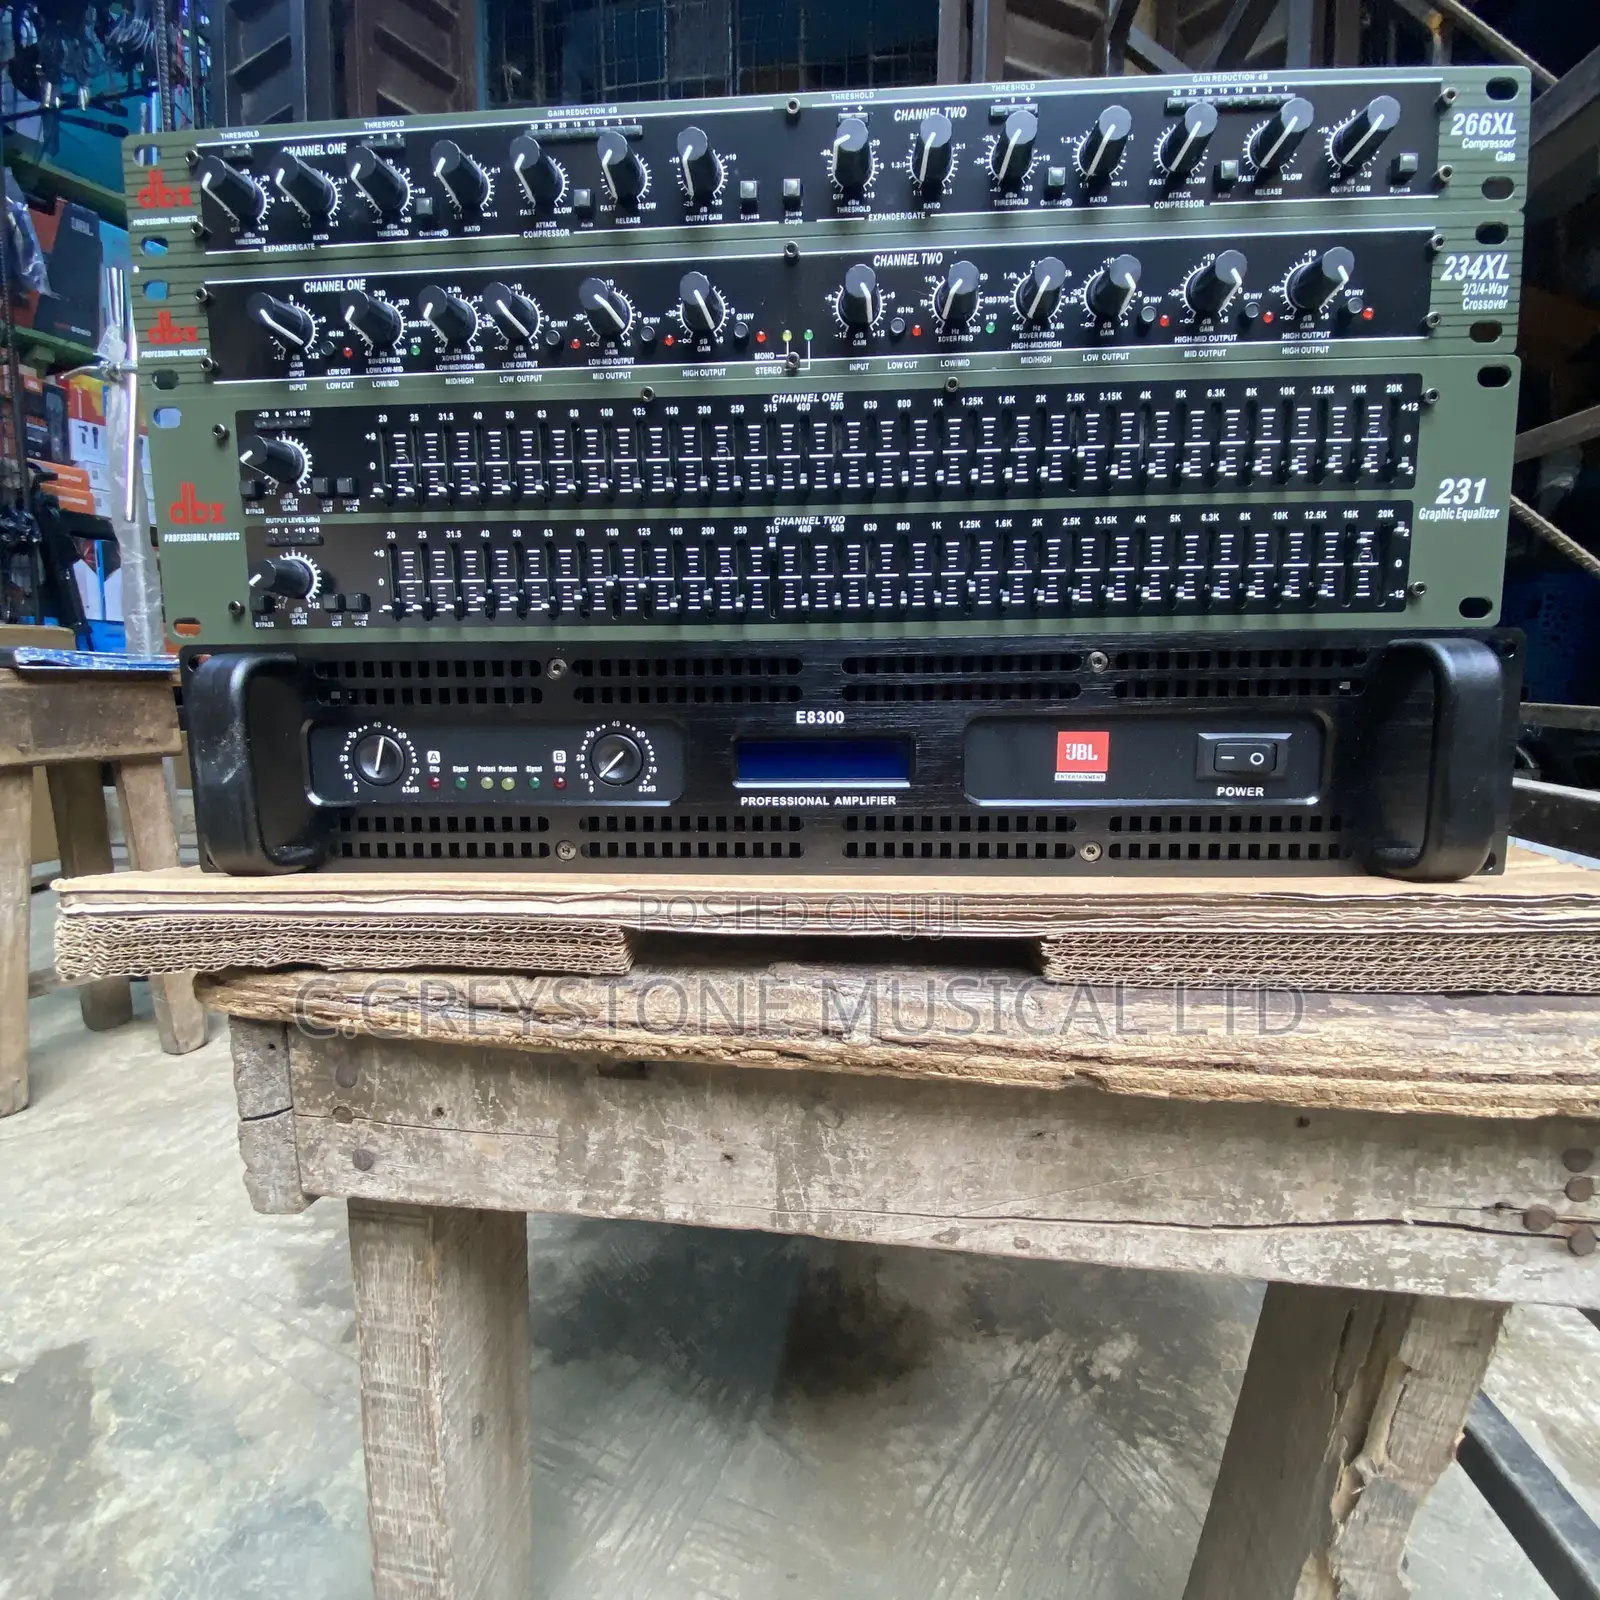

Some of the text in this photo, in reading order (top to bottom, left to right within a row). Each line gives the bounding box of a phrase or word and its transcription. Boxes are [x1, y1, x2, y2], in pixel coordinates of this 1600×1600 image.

[1193, 75, 1210, 83] GAIN
[832, 92, 874, 100] THRESHOLD
[566, 108, 605, 116] REDUCTION
[945, 106, 967, 118] TWO
[364, 120, 404, 129] THRESHOLD
[1451, 113, 1516, 135] 266XL
[220, 131, 259, 139] THRESHOLD
[327, 142, 347, 155] ONE
[1496, 151, 1516, 162] Gate
[138, 169, 192, 208] dbx
[1154, 200, 1204, 209] COMPRESSOR
[133, 218, 169, 226] PROFESSIONAL
[869, 212, 925, 221] EXPANDER/GATE
[524, 229, 569, 238] COMPRESSOR
[264, 243, 315, 252] EXPANDER/GATE
[874, 252, 943, 266] CHANNEL TWO
[1441, 254, 1510, 281] 234XL
[304, 279, 366, 292] CHANNEL ONE
[1462, 283, 1509, 297] 2/3/4-Way
[1463, 297, 1508, 310] Crossover
[148, 311, 200, 344] dbx
[141, 350, 178, 358] PROFESSIONAL
[755, 352, 774, 360] MONO
[850, 363, 869, 371] INPUT
[888, 362, 903, 370] LOW
[941, 359, 970, 367] LOW/MID
[1021, 356, 1052, 364] MID/HIGH
[1102, 352, 1130, 360] OUTPUT
[1184, 350, 1197, 358] MID
[1199, 349, 1226, 357] OUTPUT
[1301, 346, 1329, 354] OUTPUT
[327, 382, 340, 390] LOW
[341, 381, 354, 389] CUT
[372, 380, 399, 388] LOW/MID
[517, 375, 542, 383] OUTPUT
[606, 371, 631, 380] OUTPUT
[438, 413, 454, 421] 31.5
[473, 412, 482, 420] 40
[506, 411, 514, 419] 50
[537, 410, 547, 418] 63
[600, 409, 613, 417] 100
[633, 408, 646, 416] 125
[666, 407, 678, 415] 160
[698, 406, 711, 414] 200
[731, 405, 744, 413] 250
[764, 404, 777, 412] 315
[797, 403, 810, 412] 400
[831, 402, 844, 410] 500
[864, 401, 877, 409] 630
[898, 400, 911, 408] 800
[933, 399, 943, 407] 1K
[961, 397, 984, 406] 1.25K
[998, 396, 1015, 404] 1.6K
[1036, 395, 1047, 403] 2K
[1067, 393, 1085, 402] 2.5K
[1100, 392, 1122, 400] 3.15K
[1140, 391, 1151, 399] 4K
[1176, 390, 1186, 398] 5K
[1207, 389, 1225, 397] 6.3K
[1246, 388, 1257, 396] 8K
[1279, 387, 1295, 395] 10K
[1312, 386, 1334, 394] 12.5K
[1351, 385, 1367, 393] 16K
[1387, 384, 1402, 392] 20K
[772, 393, 844, 403] CHANNEL ONE
[1436, 478, 1486, 504] 231
[170, 482, 226, 525] dbx
[1419, 507, 1499, 522] Graphic Equalizer
[606, 528, 619, 536] 100
[702, 527, 715, 535] 200
[864, 523, 877, 531] 630
[932, 521, 942, 529] 1K
[1032, 518, 1043, 526] 2K
[1135, 515, 1146, 523] 4K
[1273, 512, 1288, 520] 10K
[1378, 509, 1394, 518] 20K
[774, 516, 845, 525] CHANNEL TWO
[164, 532, 240, 542] PROFESSIONAL PRODUCTS
[796, 711, 844, 724] E8300
[429, 752, 440, 762] A
[554, 751, 565, 762] B
[1066, 744, 1098, 760] JBL
[1217, 786, 1264, 797] POWER
[741, 796, 896, 806] PROFESSIONAL AMPLIFIER
